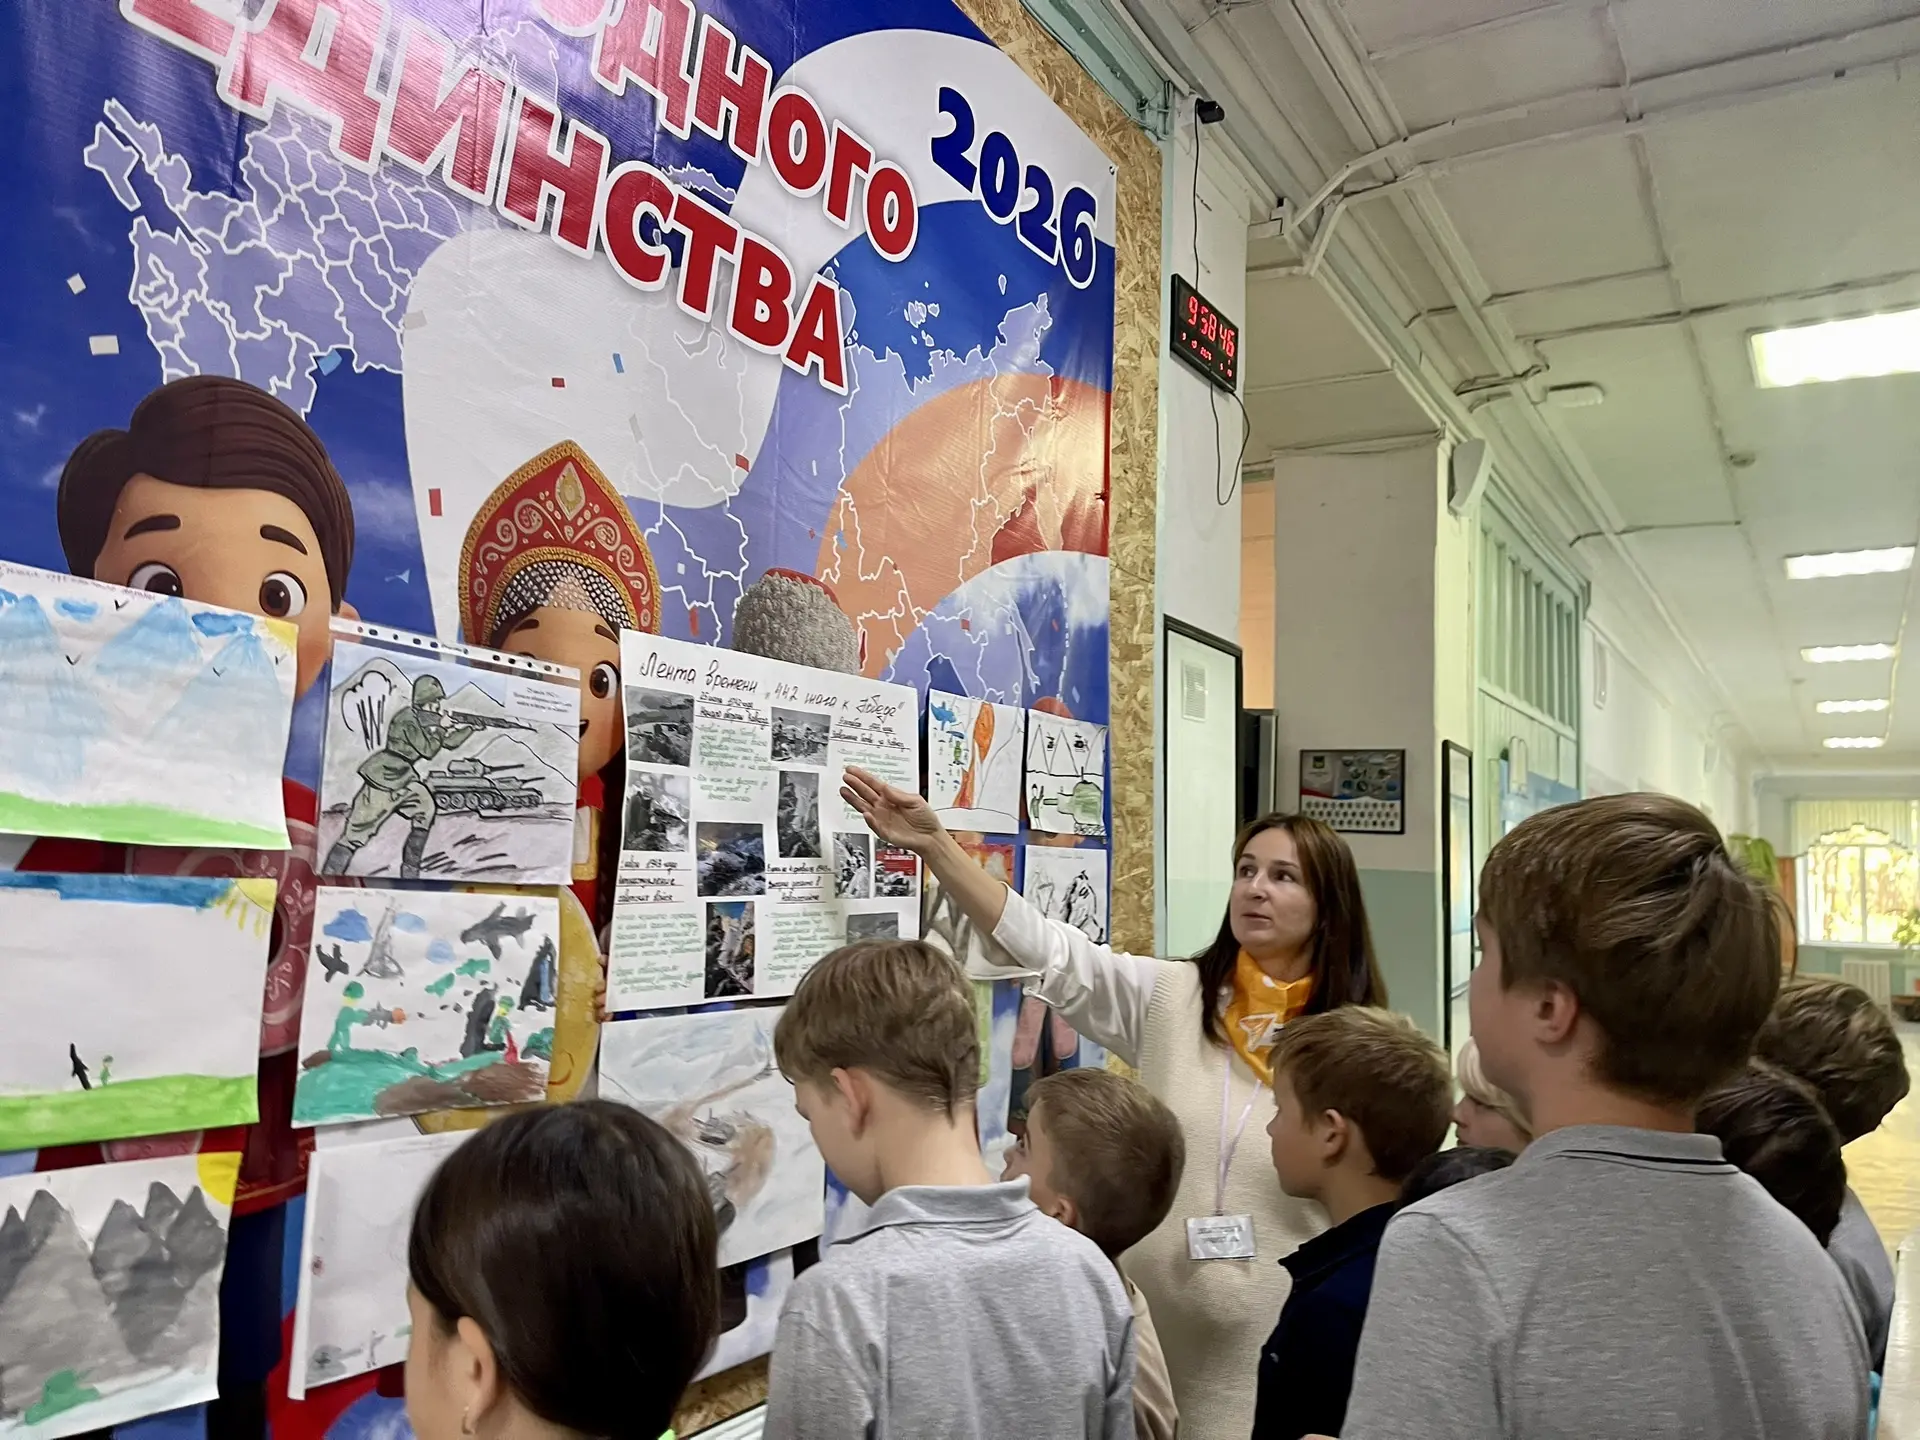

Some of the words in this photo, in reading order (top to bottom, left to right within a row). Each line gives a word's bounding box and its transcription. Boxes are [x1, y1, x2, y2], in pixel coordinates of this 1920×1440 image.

[127, 0, 848, 391] ДИНСТВА
[929, 84, 1098, 286] 2026
[640, 652, 697, 683] Лента
[803, 692, 838, 707] шага
